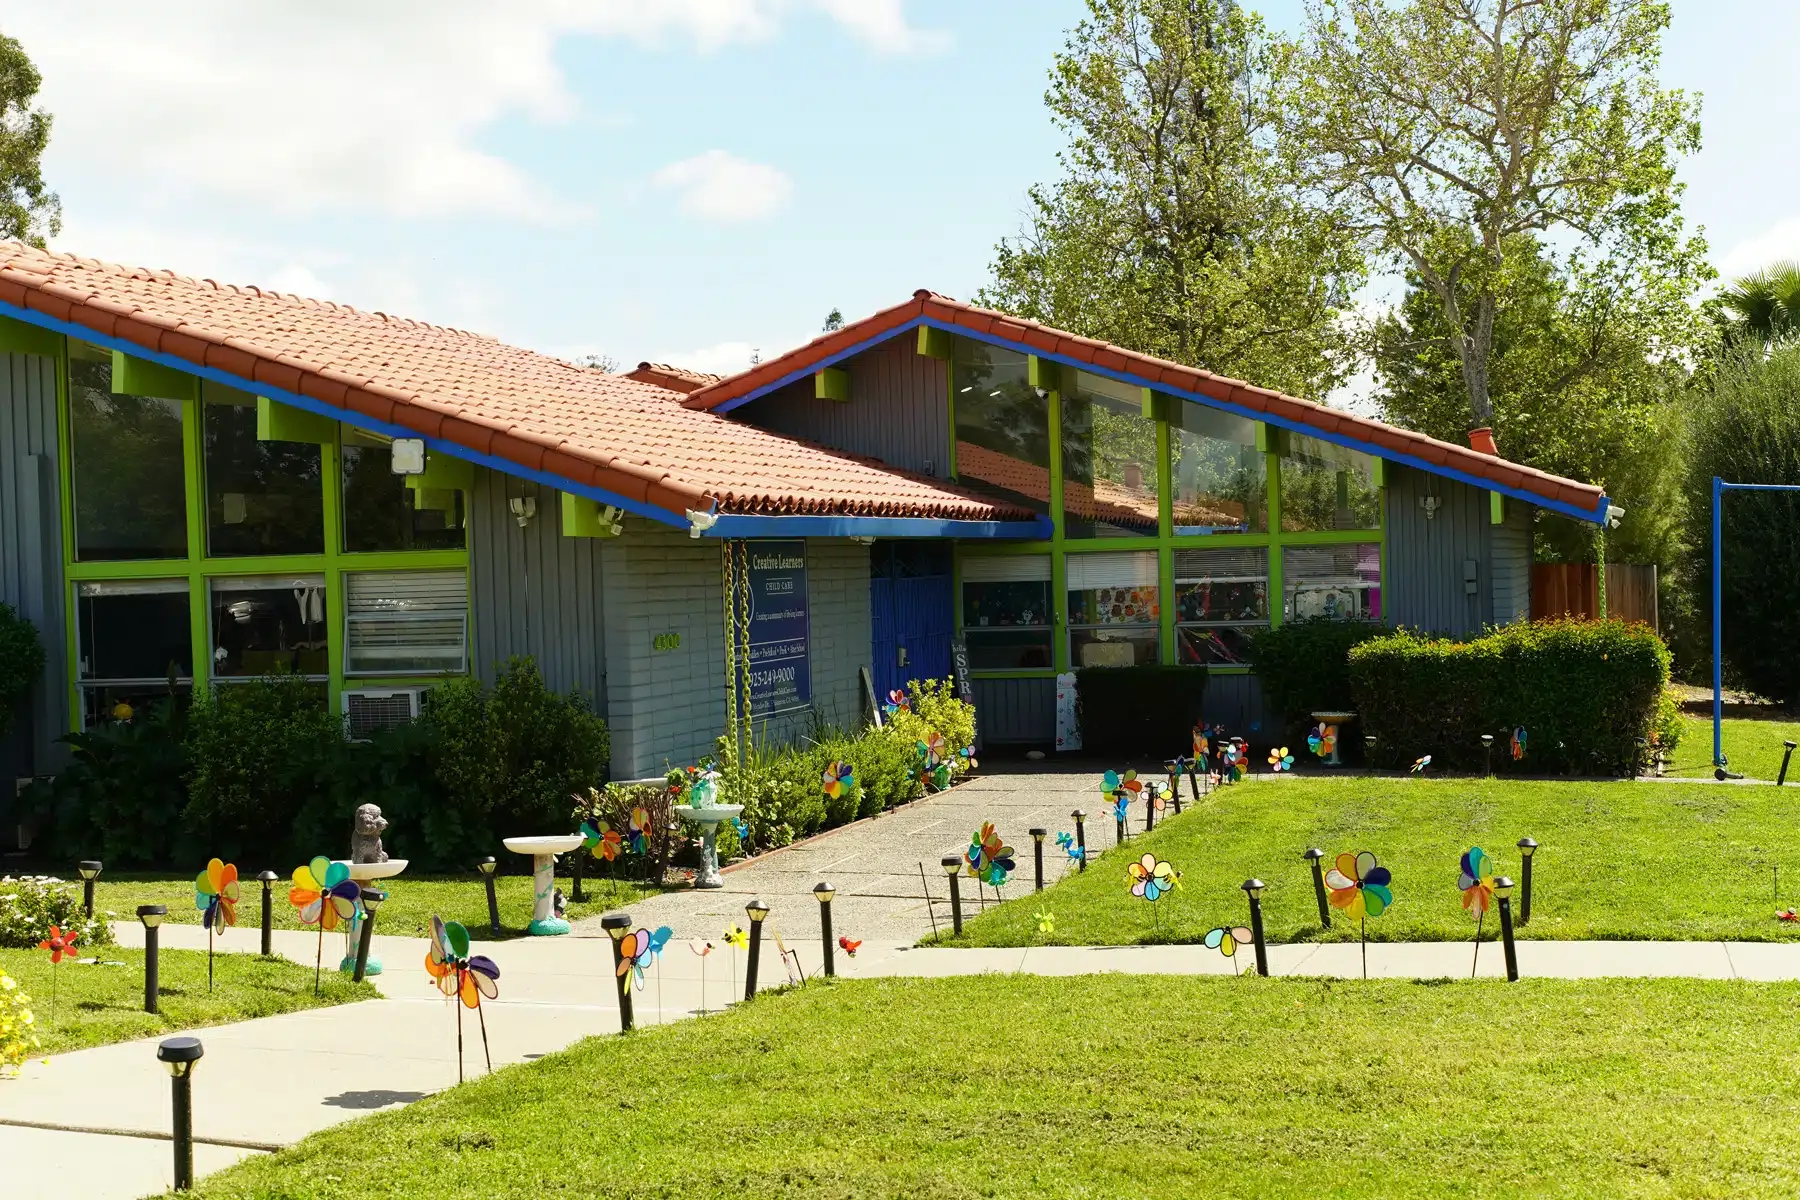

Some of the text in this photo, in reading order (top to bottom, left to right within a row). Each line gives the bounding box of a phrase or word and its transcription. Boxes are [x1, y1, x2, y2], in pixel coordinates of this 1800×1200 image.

[753, 552, 804, 570] Creative Learners
[765, 581, 793, 591] CHILD CARE
[952, 644, 967, 652] hello
[956, 653, 972, 694] SPR
